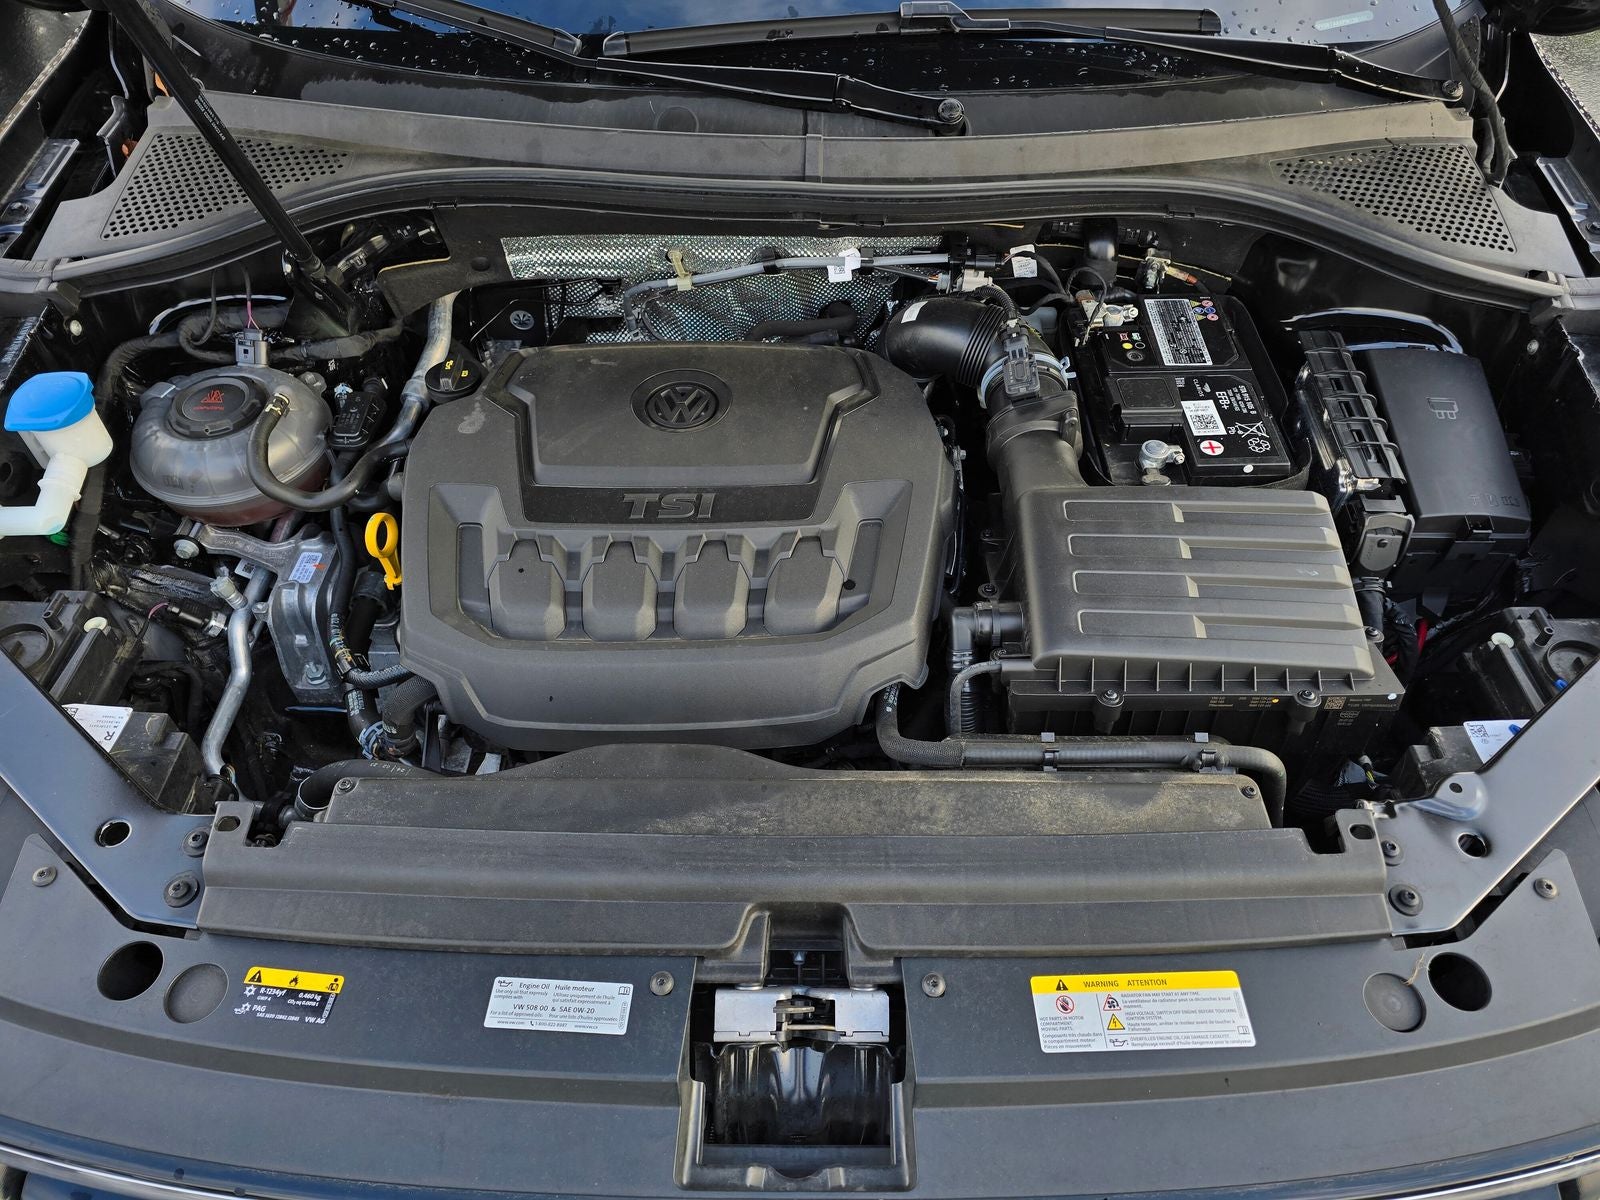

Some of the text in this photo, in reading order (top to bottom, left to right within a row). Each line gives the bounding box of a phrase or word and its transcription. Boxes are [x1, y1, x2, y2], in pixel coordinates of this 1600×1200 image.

[1193, 379, 1204, 397] CLARIOS
[650, 384, 714, 426] VW
[1216, 392, 1230, 409] EFB+
[623, 492, 717, 519] TSI
[104, 731, 115, 740] R
[260, 987, 287, 997] R-1234yf
